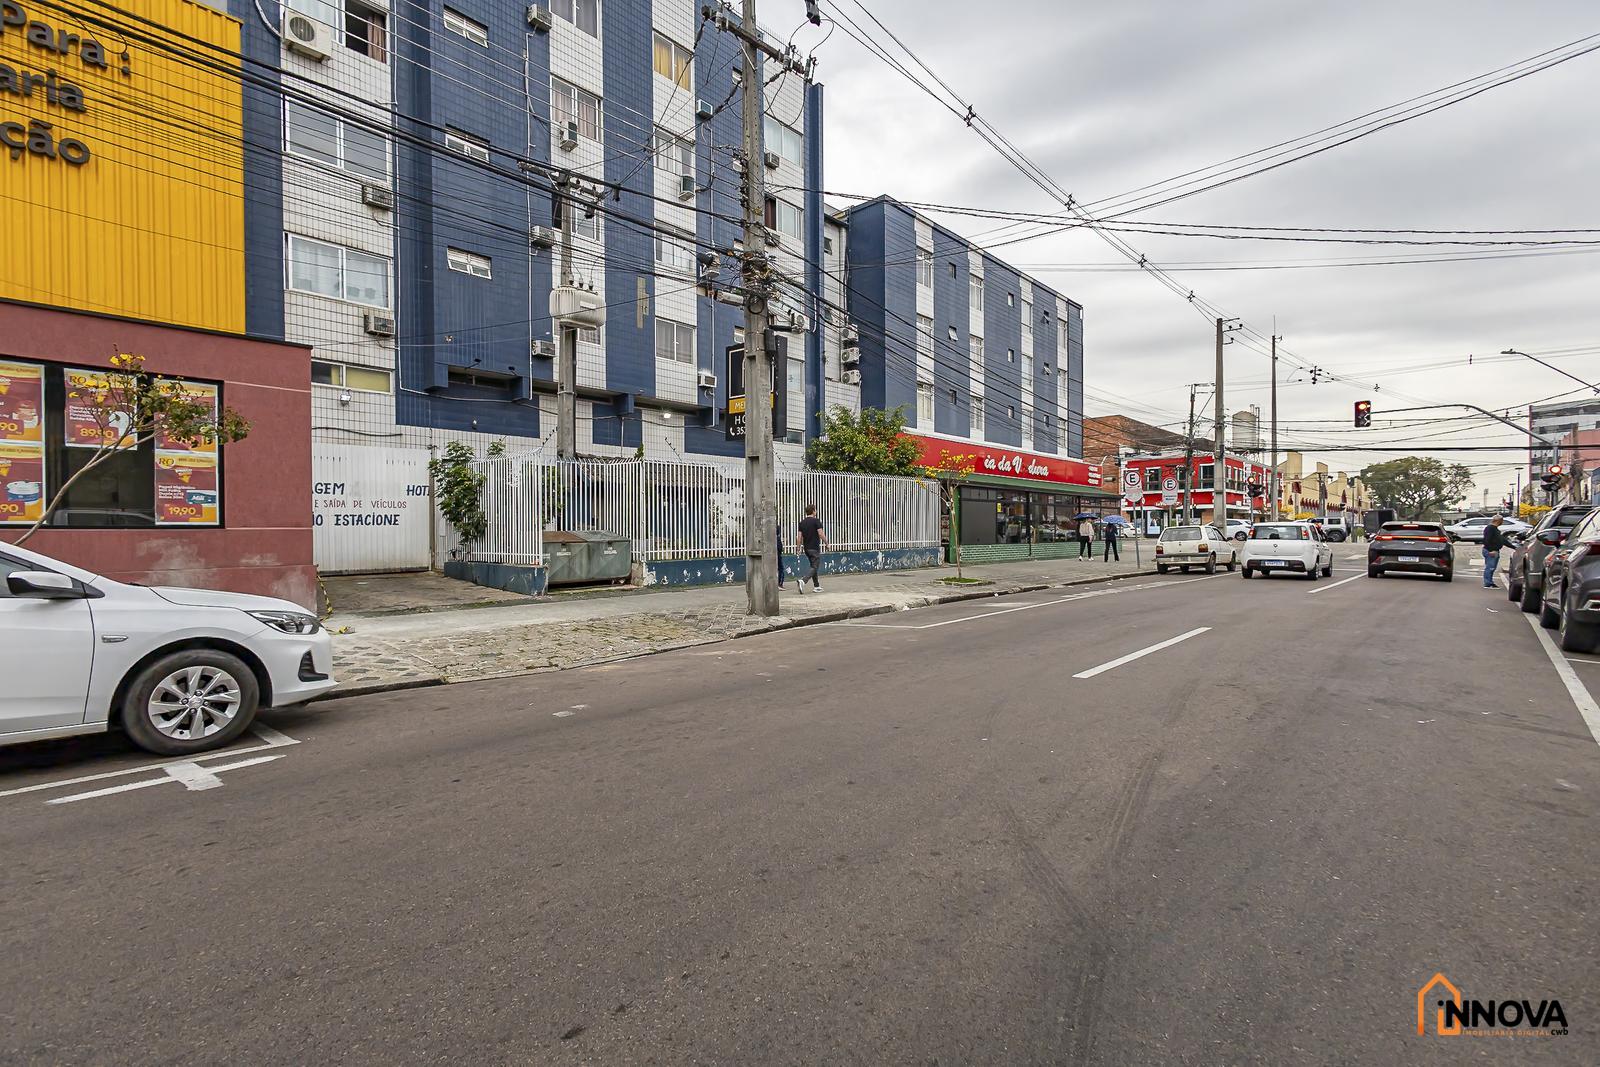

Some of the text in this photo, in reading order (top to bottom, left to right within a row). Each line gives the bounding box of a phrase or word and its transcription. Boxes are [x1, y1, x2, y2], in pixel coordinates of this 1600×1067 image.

[1129, 474, 1136, 483] E
[312, 483, 345, 495] GEM
[1166, 480, 1173, 488] E
[406, 485, 429, 496] HOT
[315, 500, 319, 508] E
[324, 498, 346, 508] SAÍDA
[371, 499, 407, 508] VEÍCULOS
[168, 506, 196, 516] 19,90
[334, 512, 400, 526] ESTACIONE
